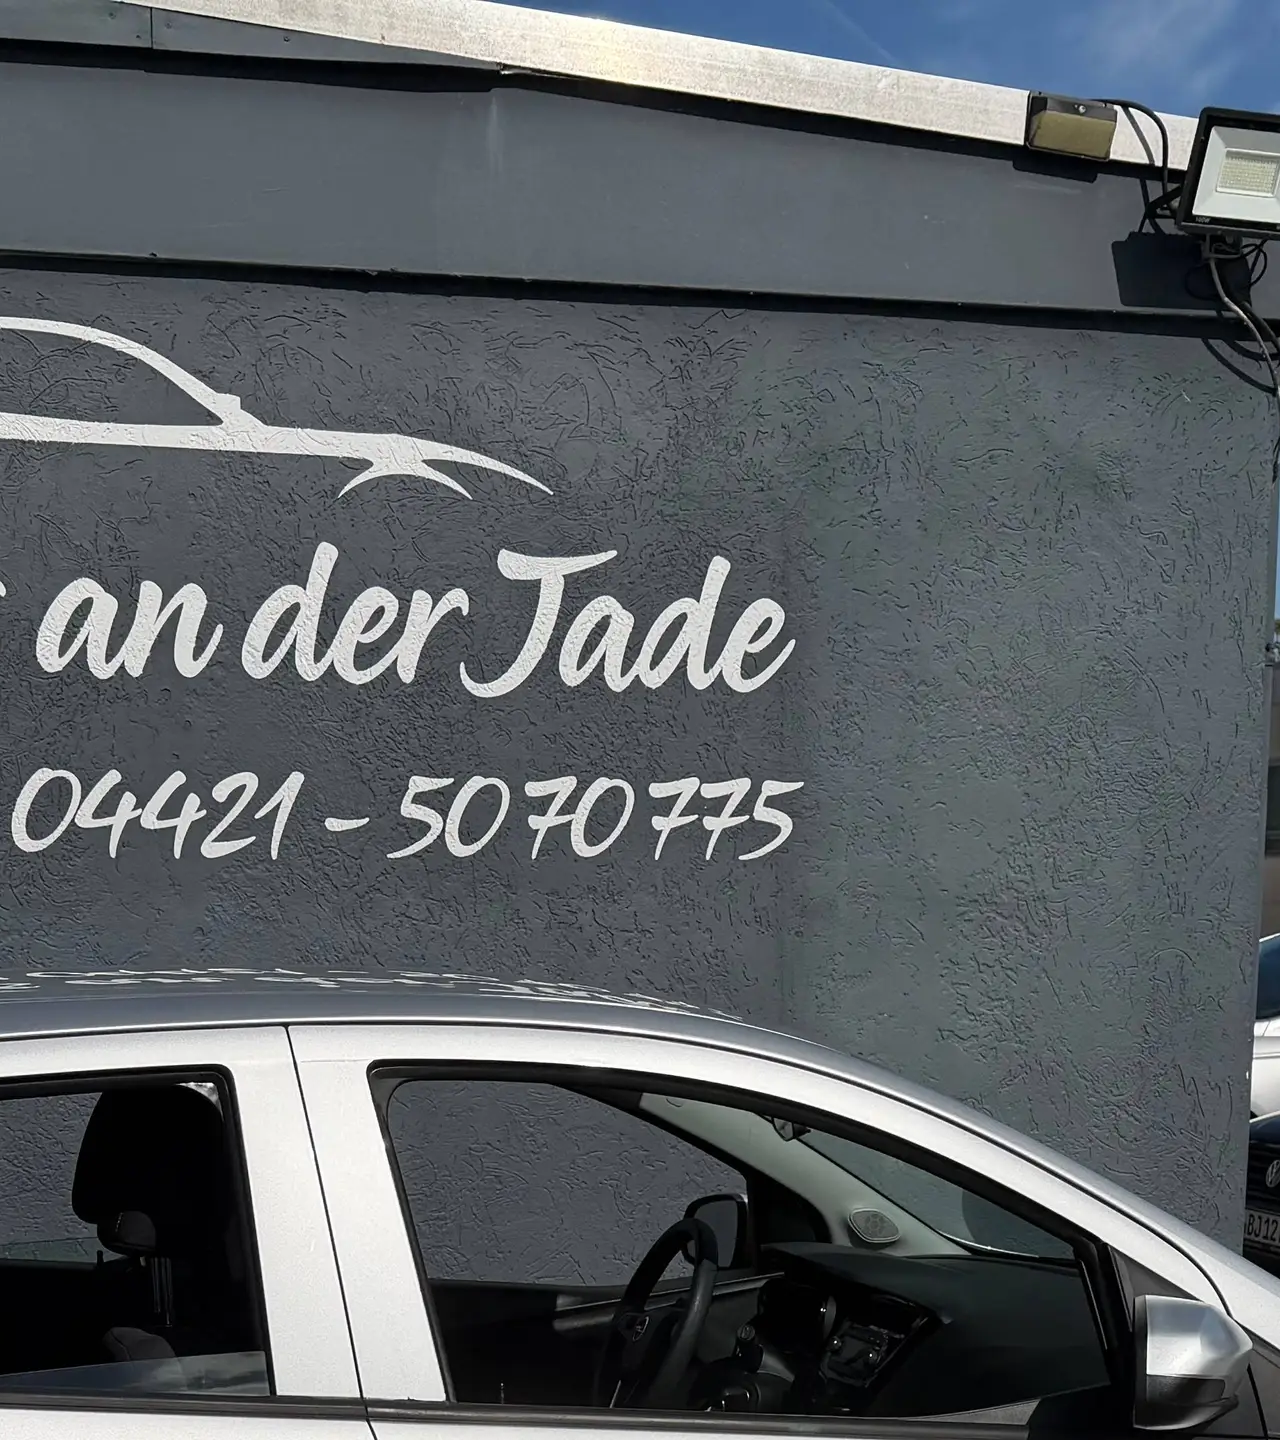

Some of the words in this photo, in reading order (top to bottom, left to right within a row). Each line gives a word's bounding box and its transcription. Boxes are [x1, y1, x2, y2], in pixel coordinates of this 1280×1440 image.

[35, 577, 224, 680] an
[241, 541, 469, 685] der
[459, 549, 796, 698] Jade
[11, 767, 305, 860] 04421
